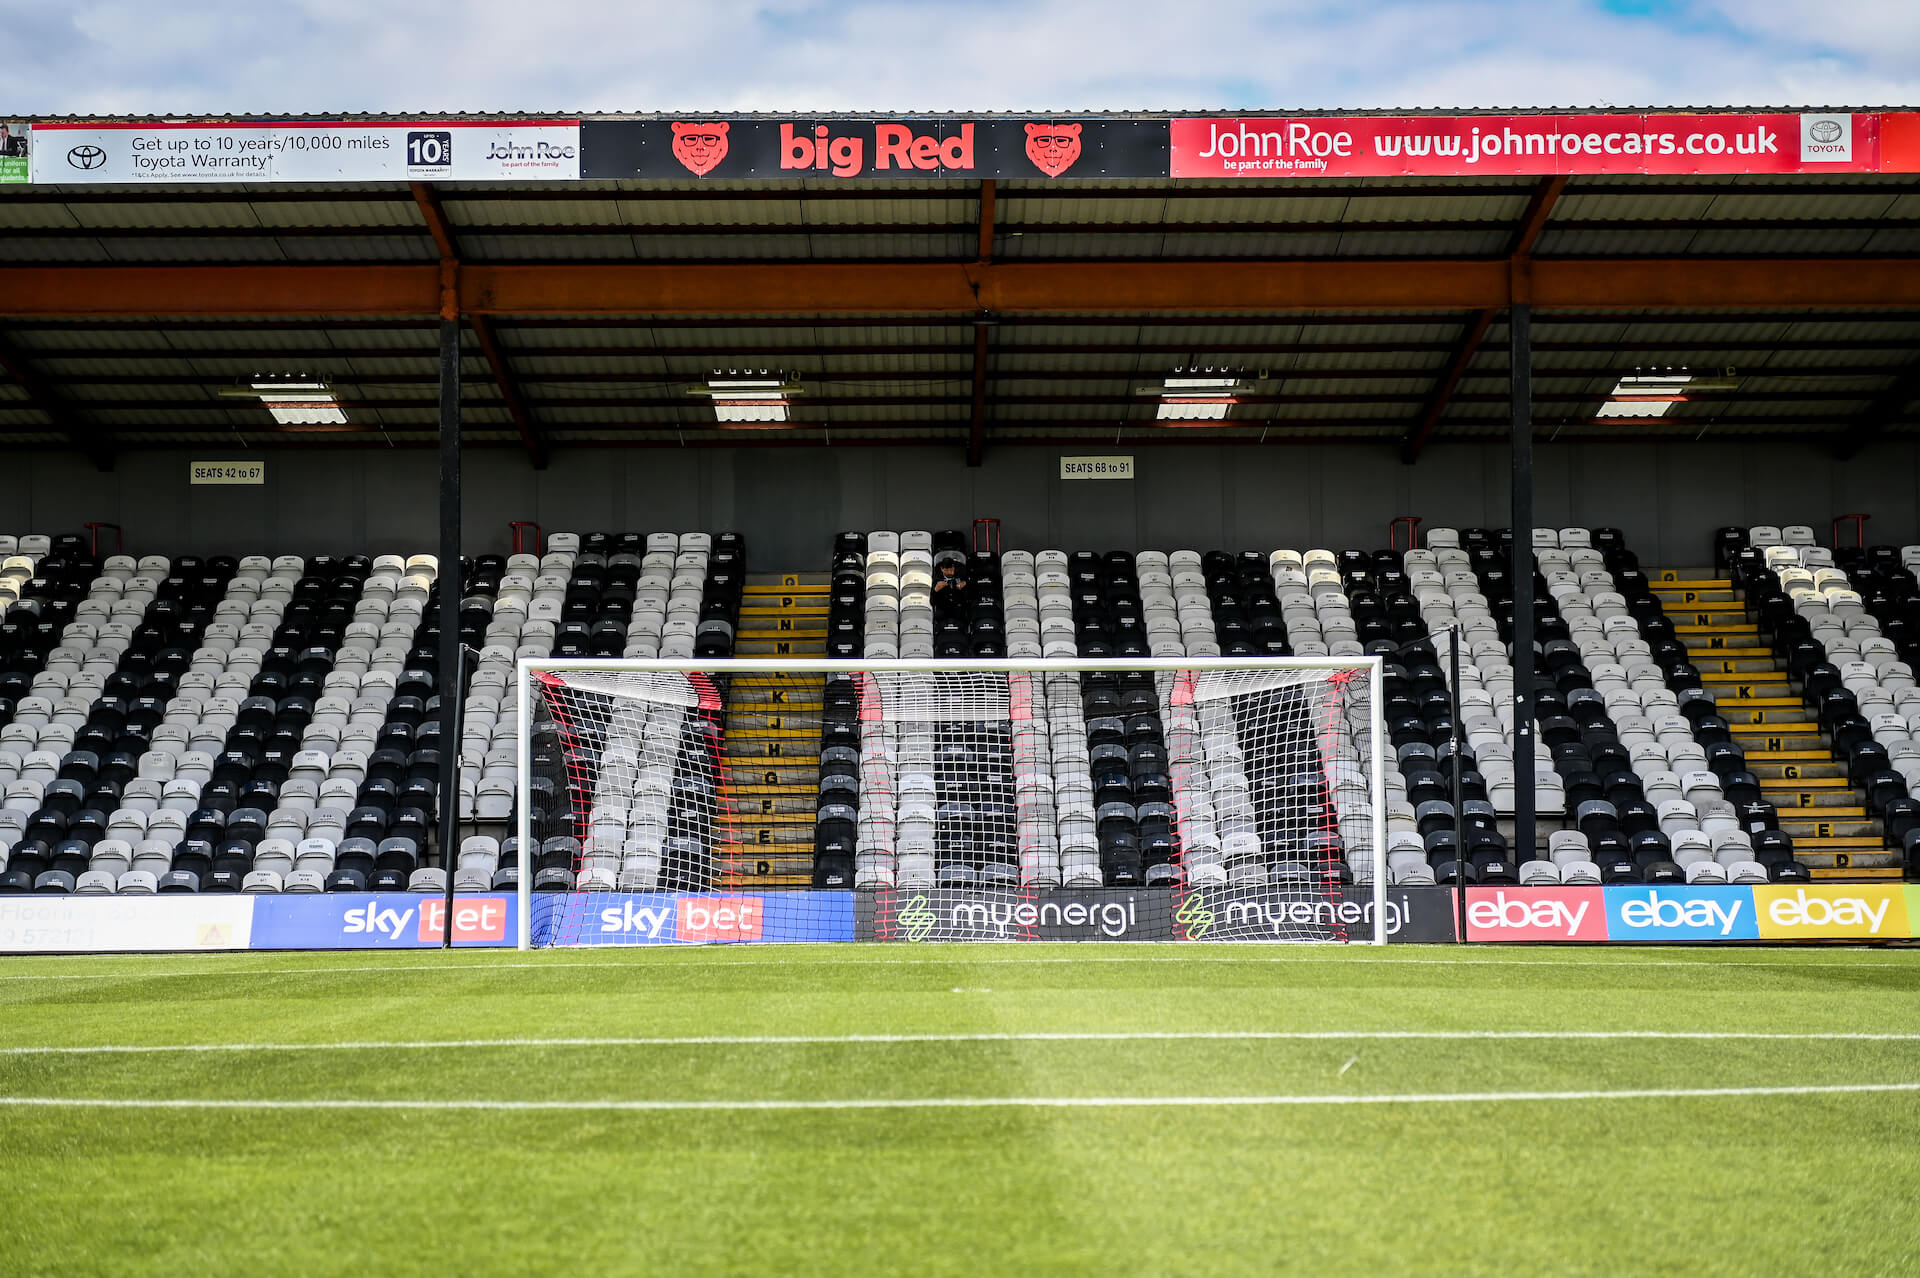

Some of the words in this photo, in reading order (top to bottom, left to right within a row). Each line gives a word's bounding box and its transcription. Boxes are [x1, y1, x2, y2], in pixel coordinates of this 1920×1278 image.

[132, 137, 161, 150] Get
[168, 140, 189, 153] up
[194, 138, 211, 150] to
[216, 137, 233, 150] 10
[239, 135, 342, 153] years/10,000
[347, 135, 390, 149] miles
[1199, 123, 1283, 157] John
[1289, 123, 1353, 157] Roe
[1374, 126, 1778, 163] www.johnroecars.co.uk
[409, 138, 442, 163] 10
[486, 141, 534, 159] John
[537, 141, 576, 159] Roe
[780, 122, 863, 178] big
[875, 122, 975, 170] Red
[1807, 145, 1846, 153] TOYOTA
[131, 154, 186, 170] Toyota
[1223, 159, 1237, 169] be
[1239, 159, 1261, 172] part
[1262, 159, 1275, 169] of
[1275, 159, 1293, 169] the
[1294, 158, 1328, 171] family
[195, 468, 223, 478] SEATS
[225, 468, 236, 478] 42
[238, 469, 247, 478] to
[249, 468, 260, 478] 67
[1065, 463, 1093, 473] SEATS
[1095, 462, 1106, 473] 68
[1109, 464, 1118, 473] to
[1119, 462, 1130, 472] 91
[782, 597, 793, 607] P
[1685, 592, 1695, 603] P
[780, 619, 791, 630] N
[1697, 614, 1708, 626] N
[777, 643, 790, 654] M
[1710, 638, 1723, 648] M
[1723, 661, 1733, 673] L
[773, 691, 785, 703] K
[1738, 687, 1751, 699] K
[1753, 712, 1763, 724] J
[768, 743, 780, 756] H
[1768, 738, 1781, 751] H
[765, 772, 778, 785] G
[1784, 766, 1798, 779] G
[762, 800, 772, 814] F
[1800, 793, 1811, 808] F
[759, 830, 770, 844] E
[1818, 823, 1830, 837] E
[757, 861, 770, 875] D
[1836, 854, 1849, 868] D
[953, 897, 1136, 937] myenergi
[1468, 891, 1590, 936] ebay
[1621, 890, 1743, 935] ebay
[1769, 889, 1890, 934] ebay
[343, 901, 415, 940] sky
[429, 902, 497, 931] bet
[601, 900, 671, 938] sky
[686, 901, 753, 930] bet
